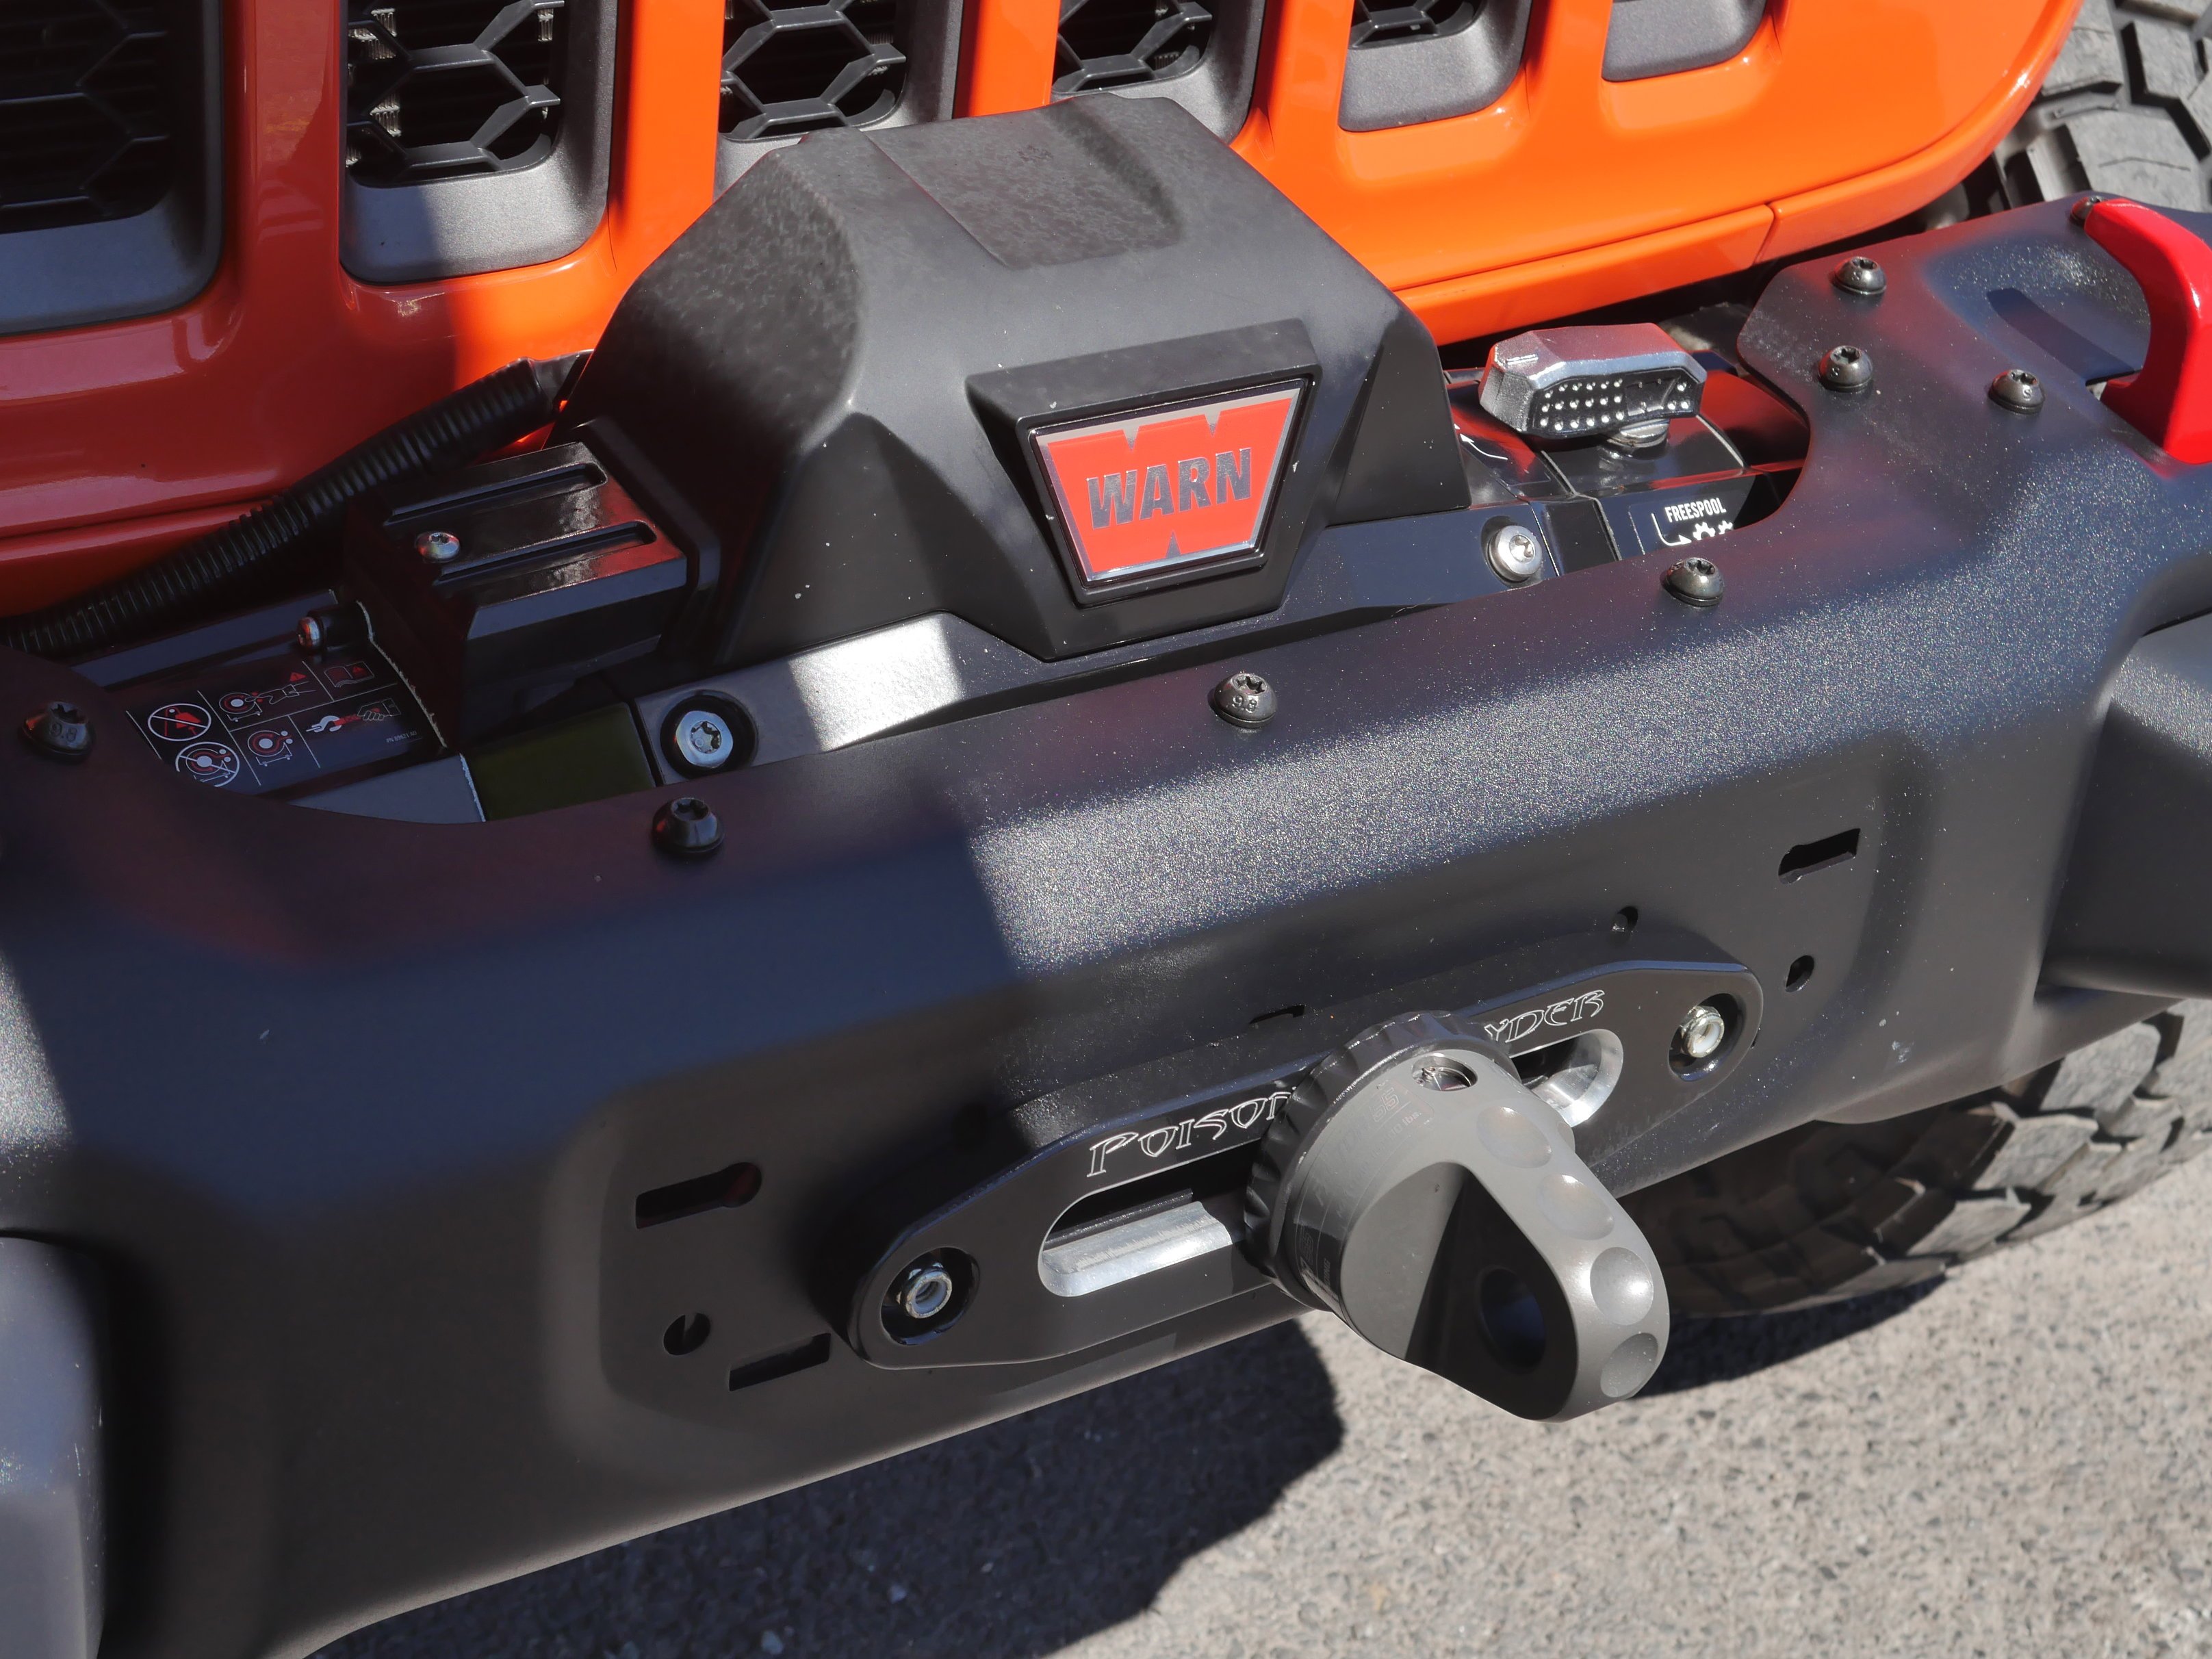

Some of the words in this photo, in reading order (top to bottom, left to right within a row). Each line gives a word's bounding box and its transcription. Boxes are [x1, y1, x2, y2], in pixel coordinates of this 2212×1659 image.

[1087, 447, 1252, 530] WARN
[1664, 498, 1727, 523] FREESPOOL
[1484, 989, 1605, 1044] YDER
